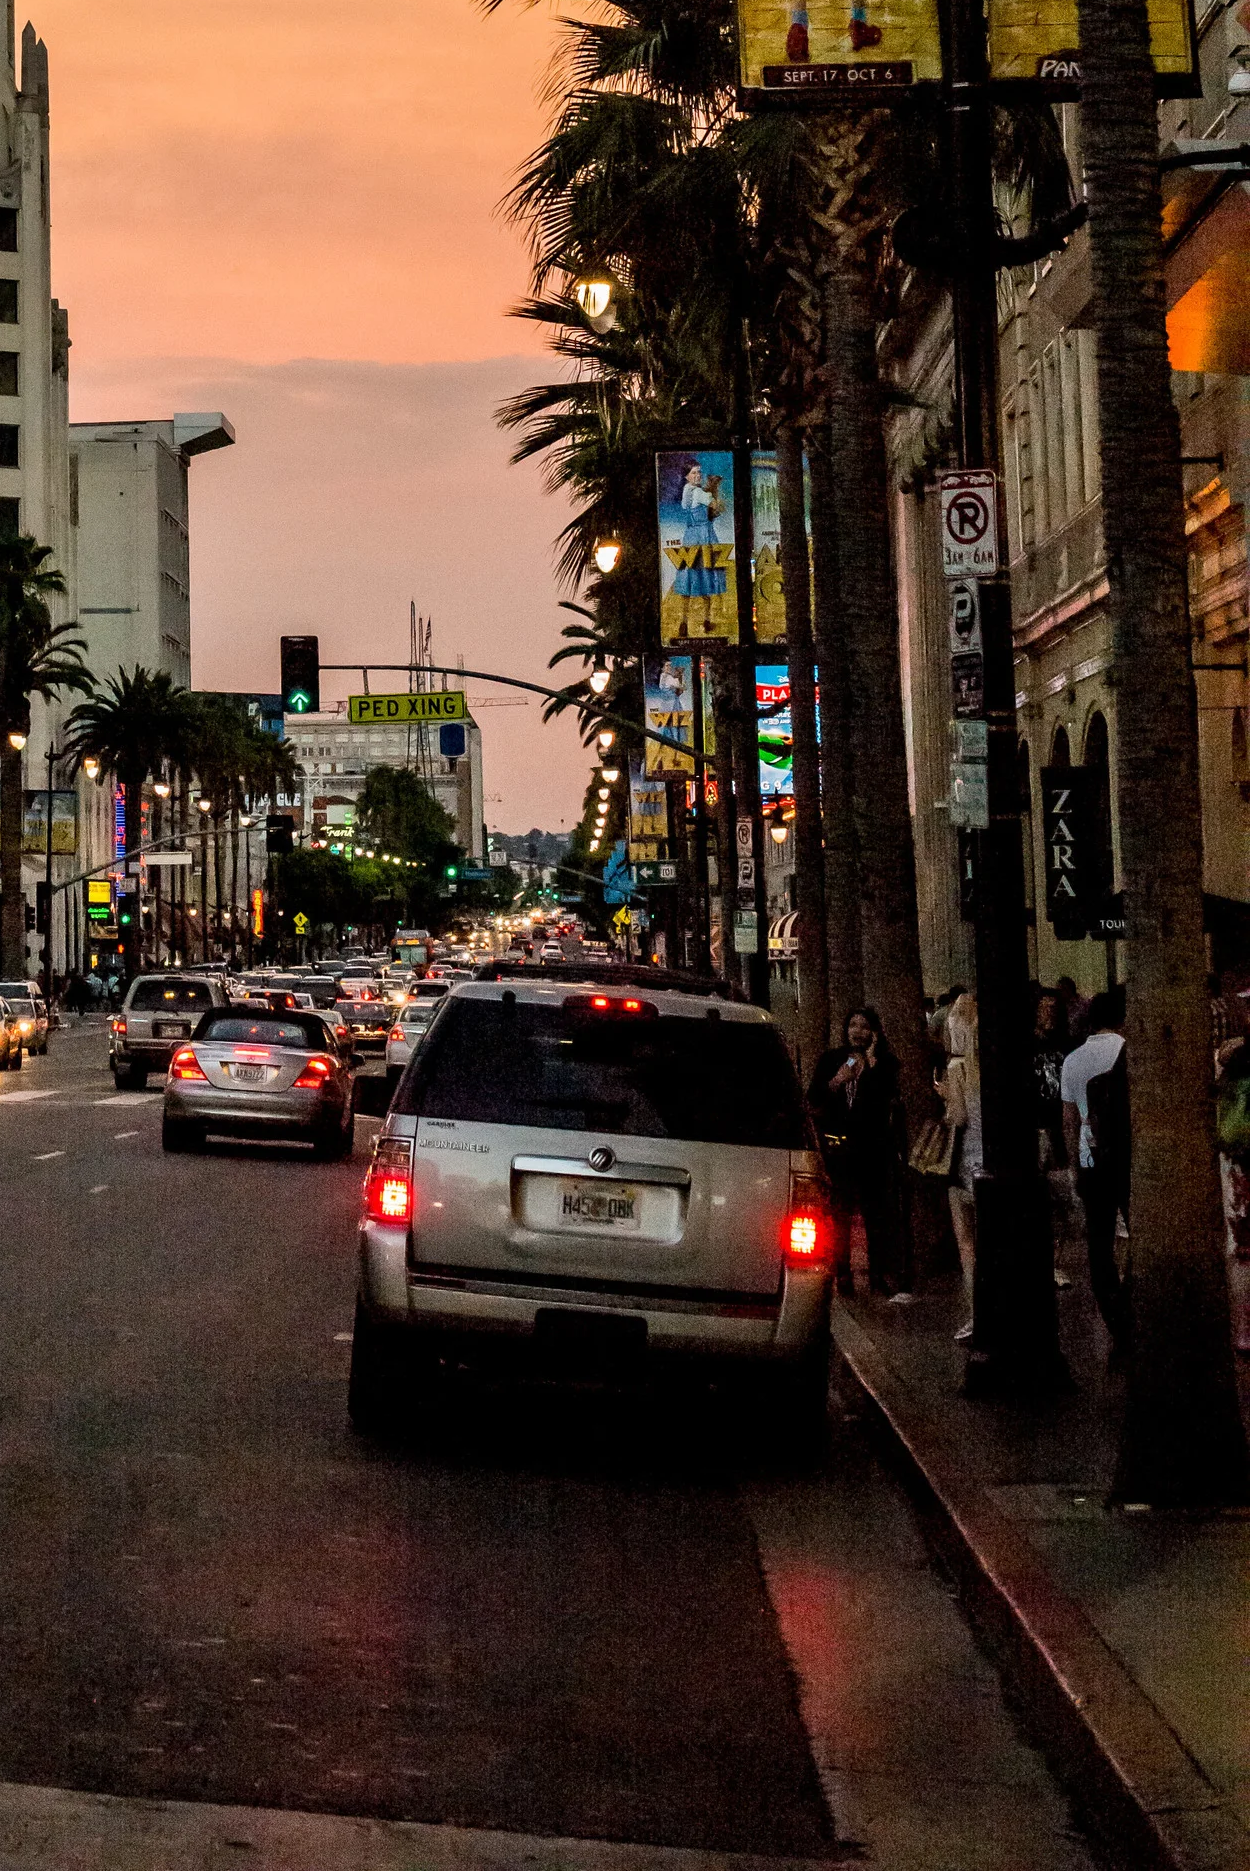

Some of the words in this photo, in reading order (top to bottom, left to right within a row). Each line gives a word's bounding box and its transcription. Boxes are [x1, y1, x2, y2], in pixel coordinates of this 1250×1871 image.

[783, 70, 818, 84] SEPT.
[822, 69, 837, 82] 17
[885, 67, 894, 80] 6
[666, 538, 681, 546] THE
[663, 543, 735, 570] WIZ
[973, 548, 995, 565] 6AM
[358, 699, 400, 718] PED
[408, 696, 456, 716] XING
[648, 711, 694, 728] WIZ
[320, 825, 355, 838] Frank
[1050, 789, 1077, 898] ZARA
[419, 1138, 490, 1154] MOUNTAINEER
